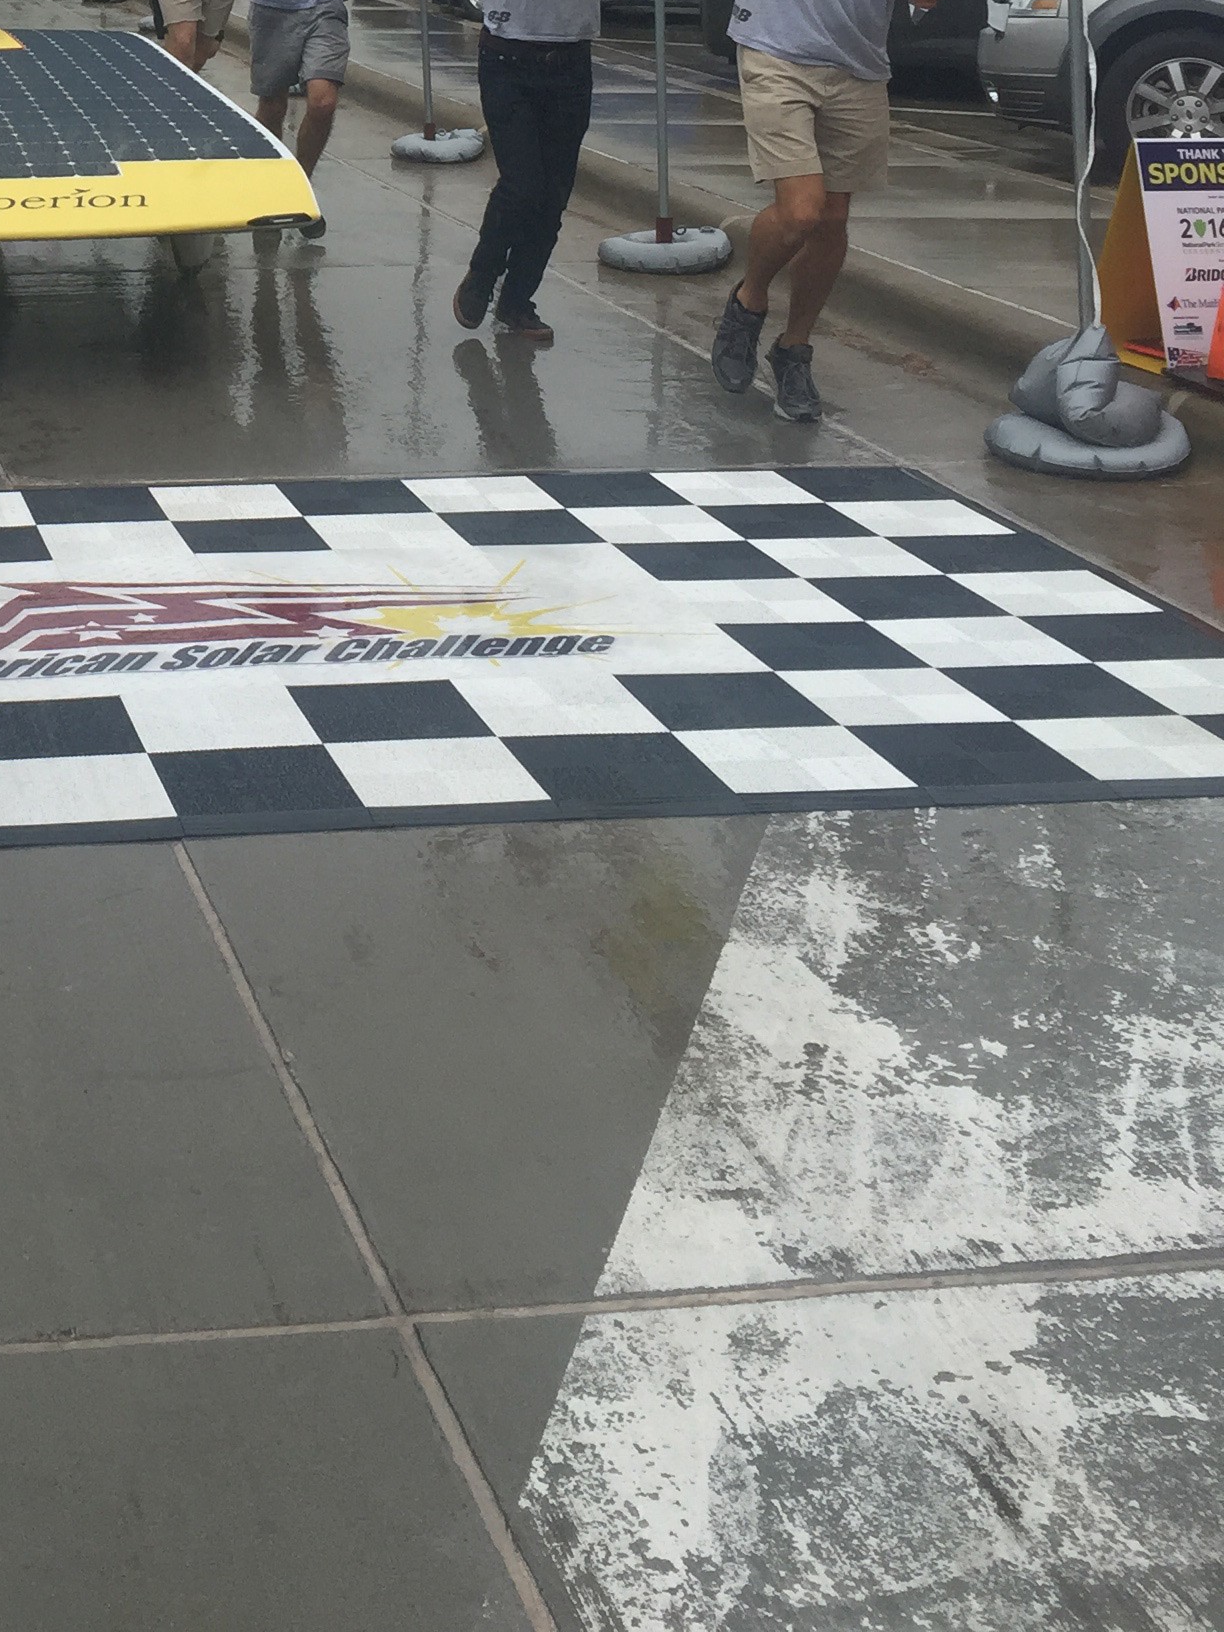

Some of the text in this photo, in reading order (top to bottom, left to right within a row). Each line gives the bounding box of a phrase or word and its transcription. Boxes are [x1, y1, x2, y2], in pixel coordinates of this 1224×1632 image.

[1177, 148, 1221, 160] THANK
[160, 641, 322, 670] Solar
[324, 634, 615, 662] Challenge
